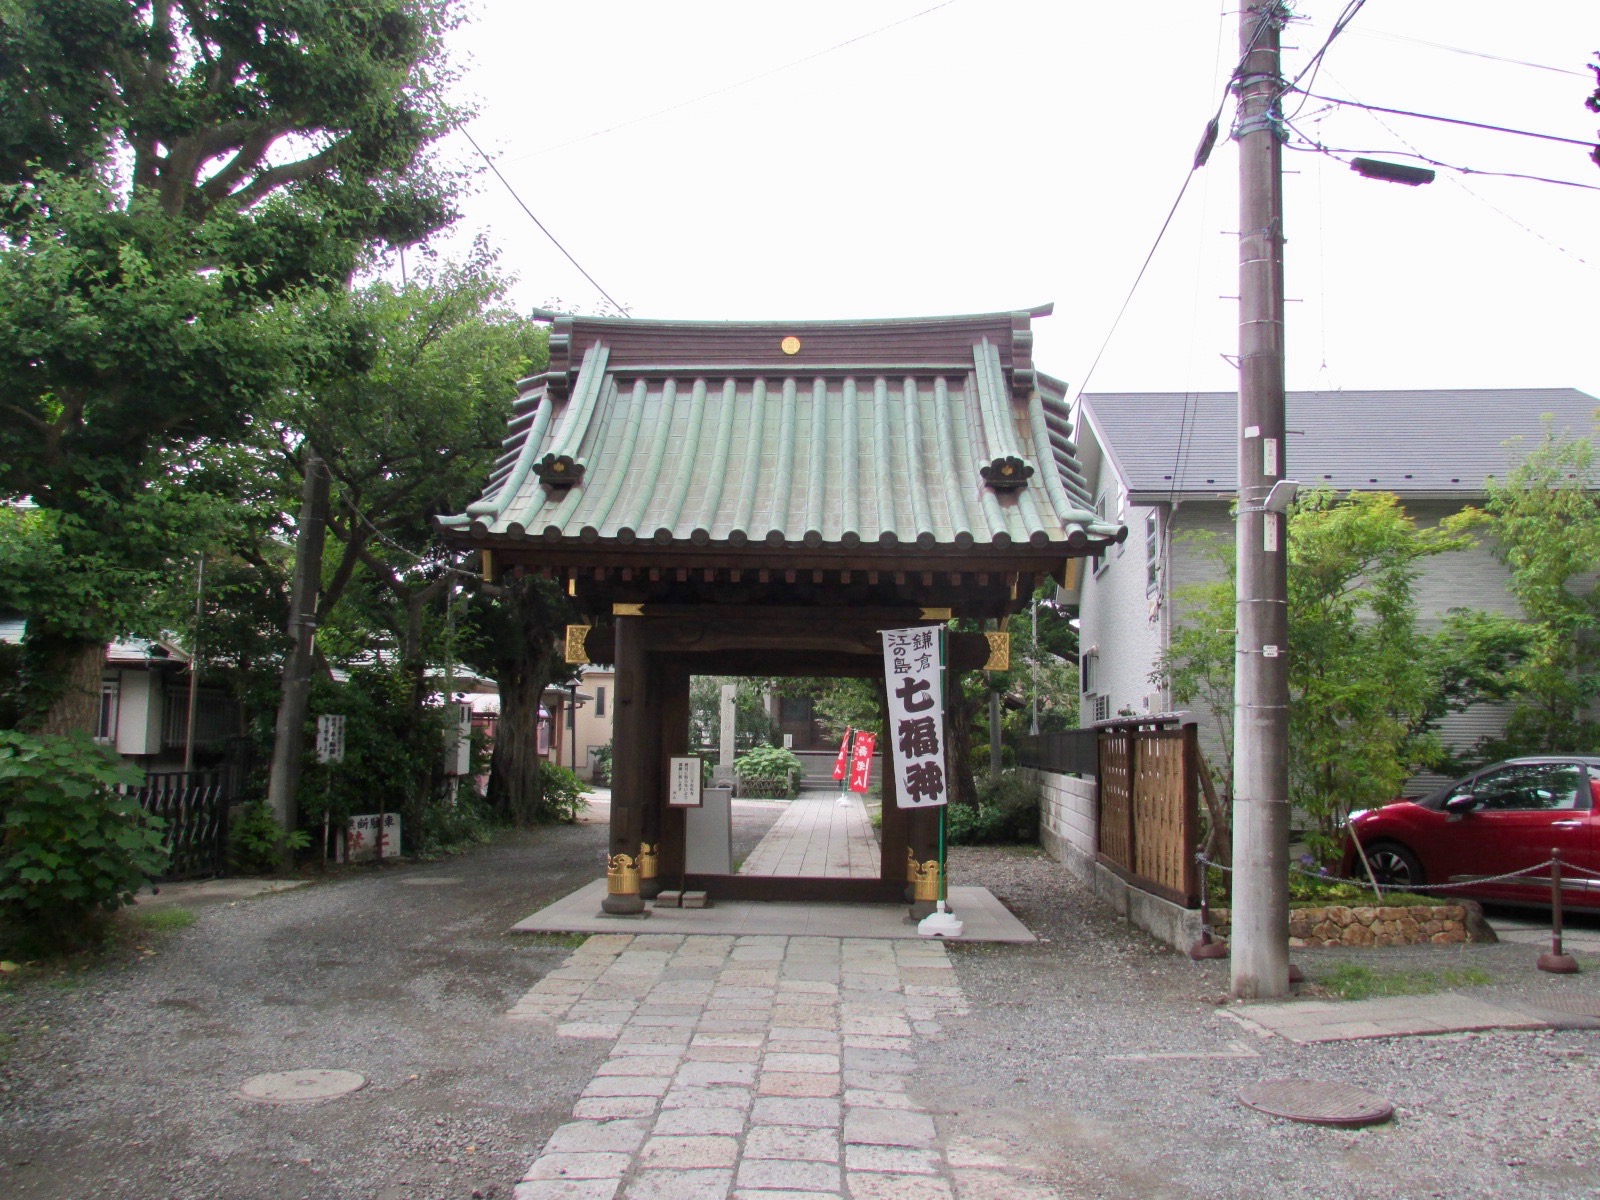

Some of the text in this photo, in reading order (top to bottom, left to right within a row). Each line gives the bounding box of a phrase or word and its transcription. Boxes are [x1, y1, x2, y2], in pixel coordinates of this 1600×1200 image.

[887, 633, 912, 674] 江の島
[911, 629, 934, 673] 鎌倉
[895, 676, 944, 804] 七福神
